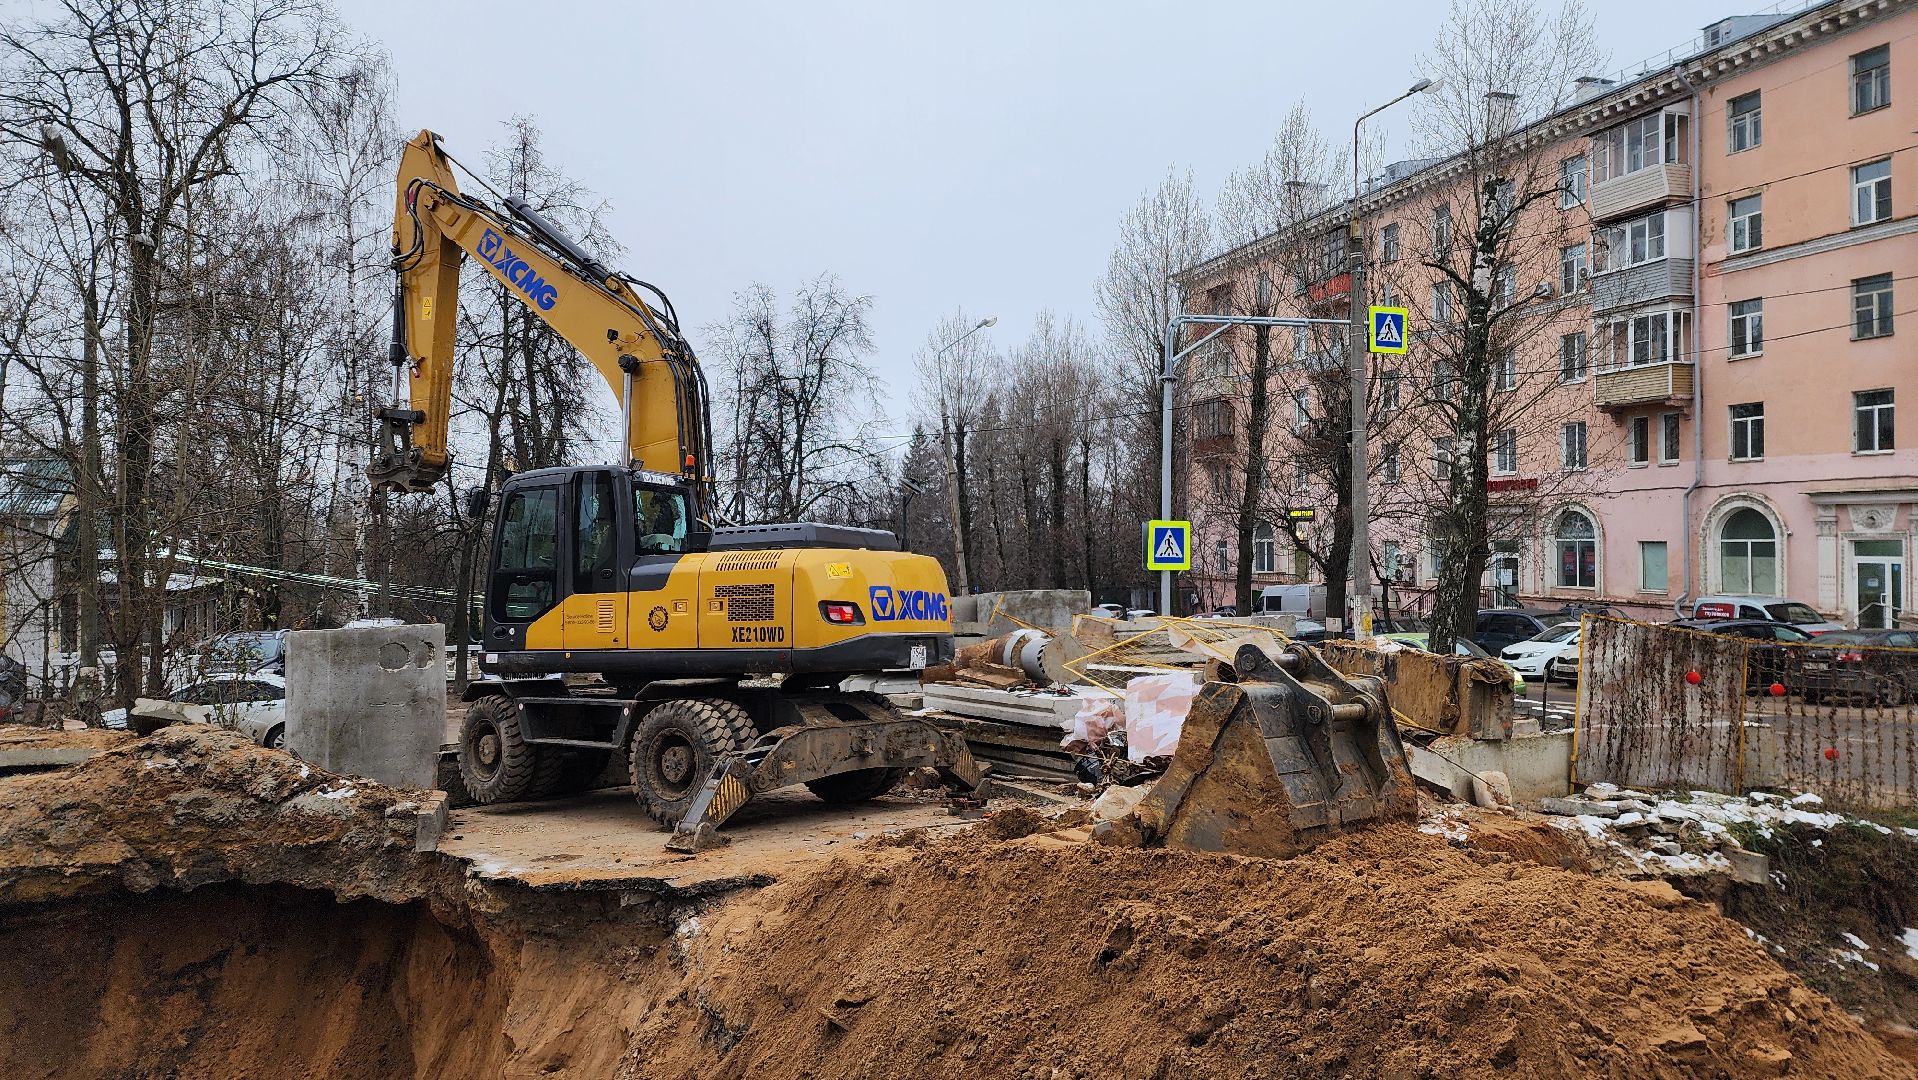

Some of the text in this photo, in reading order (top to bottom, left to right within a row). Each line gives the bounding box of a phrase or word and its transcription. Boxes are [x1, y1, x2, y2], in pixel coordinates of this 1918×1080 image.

[492, 245, 558, 311] XCMG
[896, 590, 948, 621] XCMG
[731, 626, 785, 643] XE210WD
